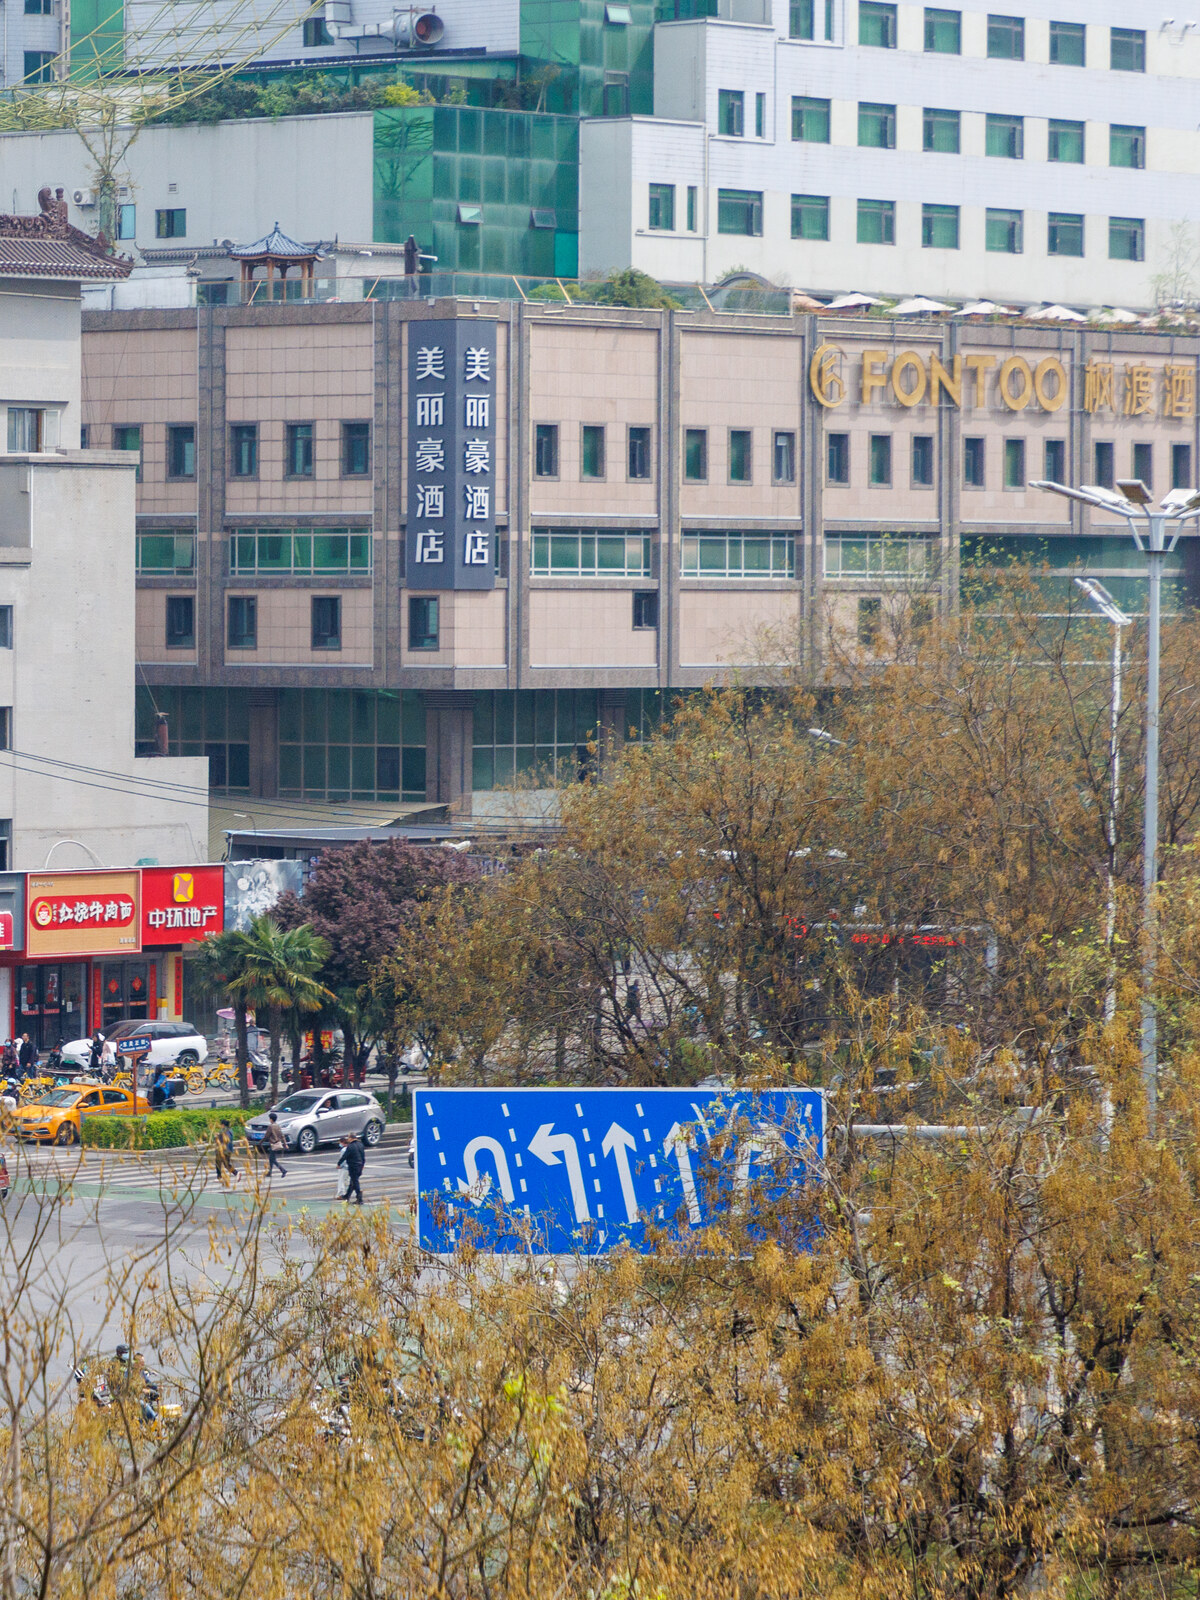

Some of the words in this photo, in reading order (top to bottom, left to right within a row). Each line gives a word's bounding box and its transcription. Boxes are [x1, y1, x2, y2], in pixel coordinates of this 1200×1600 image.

[861, 350, 1067, 412] FONTOO
[1083, 357, 1195, 418] 枫渡酒
[415, 346, 446, 564] 美丽豪酒店
[464, 347, 491, 565] 美丽豪酒店
[59, 901, 132, 923] 红烧牛肉面
[149, 905, 218, 928] 中环地产
